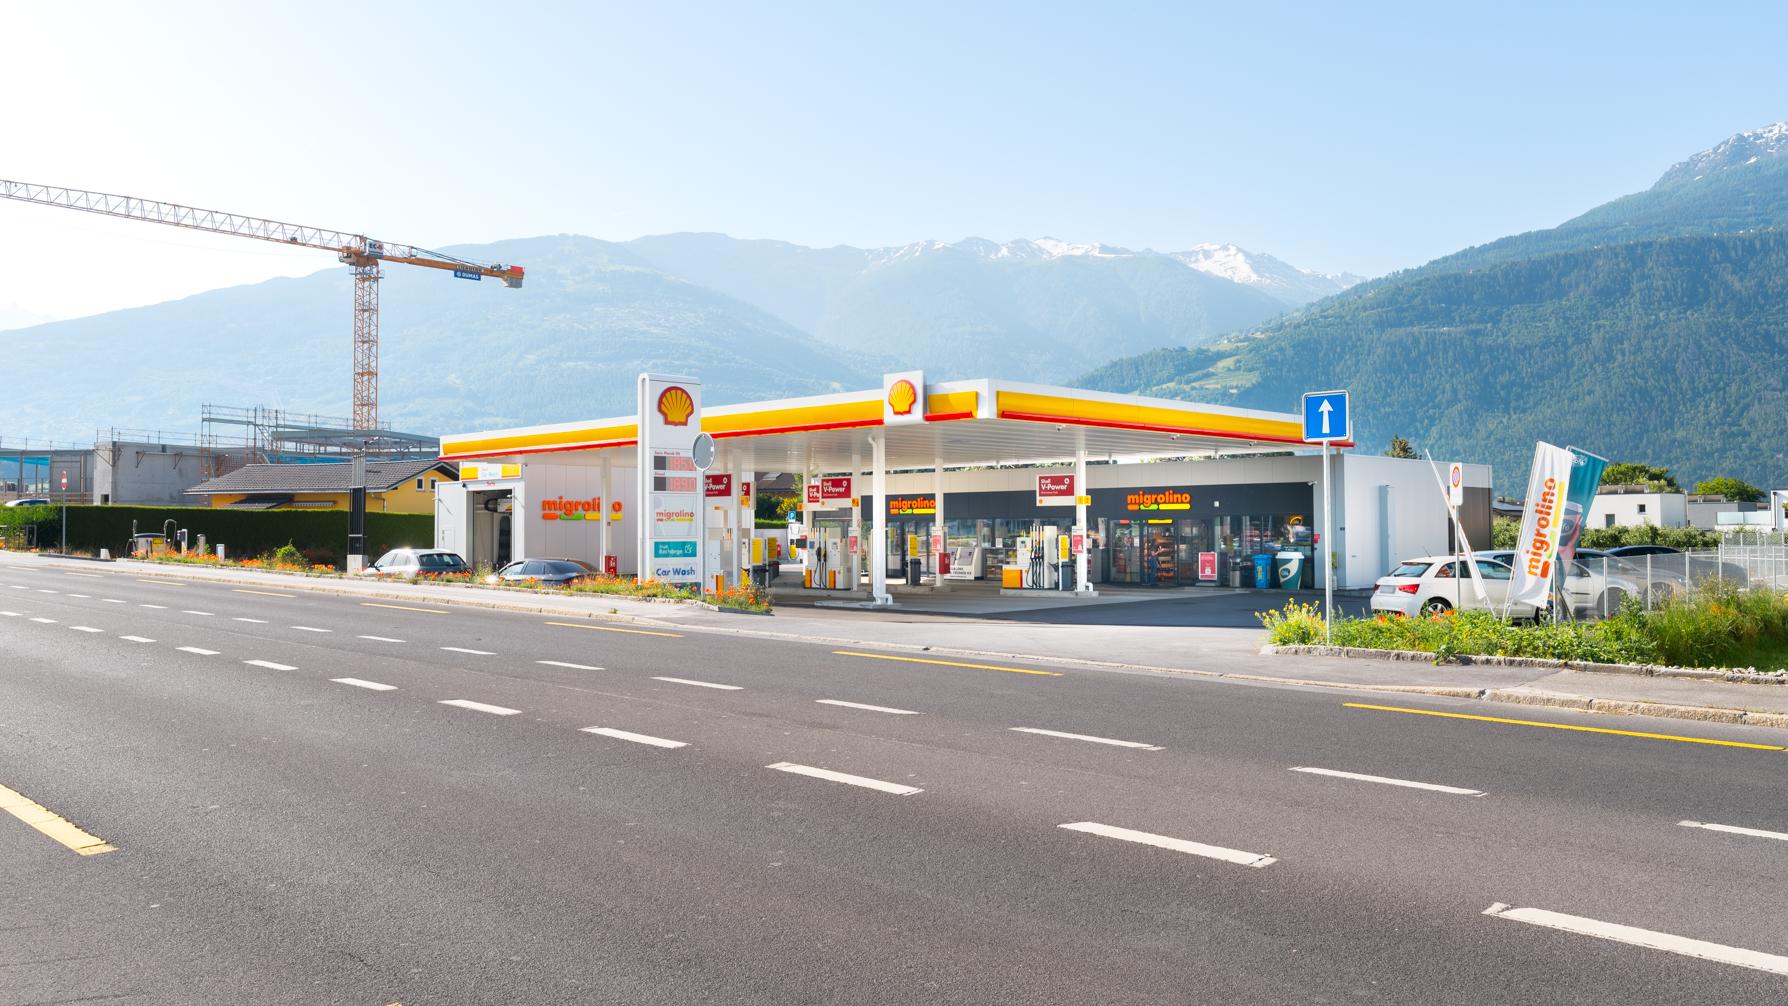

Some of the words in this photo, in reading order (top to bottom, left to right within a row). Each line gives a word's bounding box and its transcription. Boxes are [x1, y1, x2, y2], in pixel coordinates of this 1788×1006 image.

[542, 496, 623, 516] migrolio
[889, 497, 936, 512] migrolino
[1127, 490, 1191, 507] migrolino
[656, 509, 695, 519] migrolino
[1527, 477, 1556, 577] migrolino
[656, 568, 671, 576] Car
[672, 566, 696, 576] Wash
